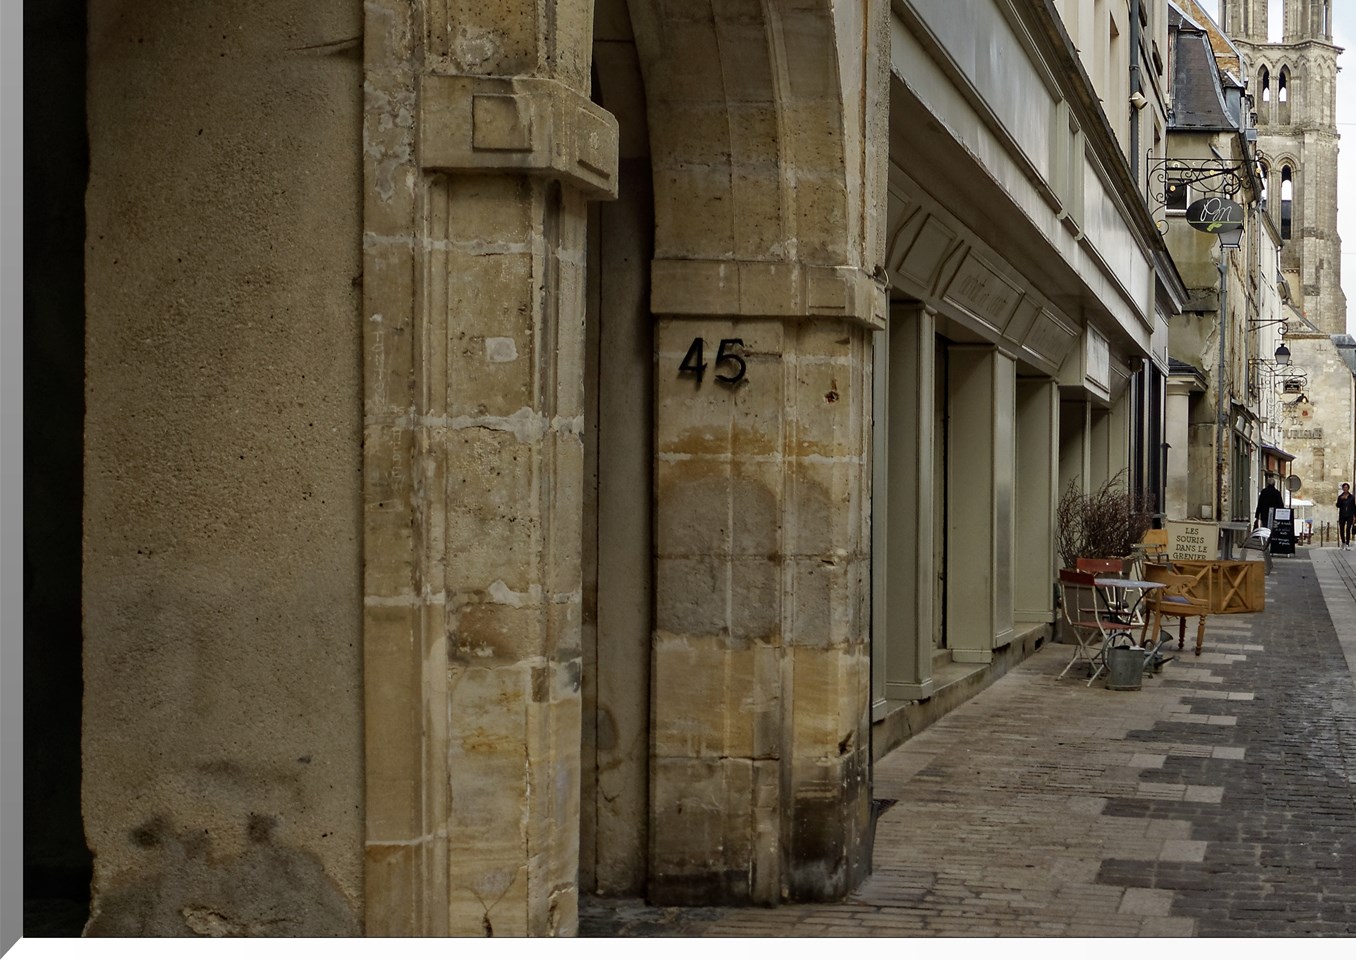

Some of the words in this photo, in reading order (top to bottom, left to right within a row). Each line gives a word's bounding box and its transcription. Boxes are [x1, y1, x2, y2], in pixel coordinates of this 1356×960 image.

[678, 337, 747, 384] 45
[1184, 527, 1199, 535] LES
[1175, 535, 1204, 543] SOURIS
[1175, 543, 1195, 552] DANS
[1197, 545, 1207, 553] LE
